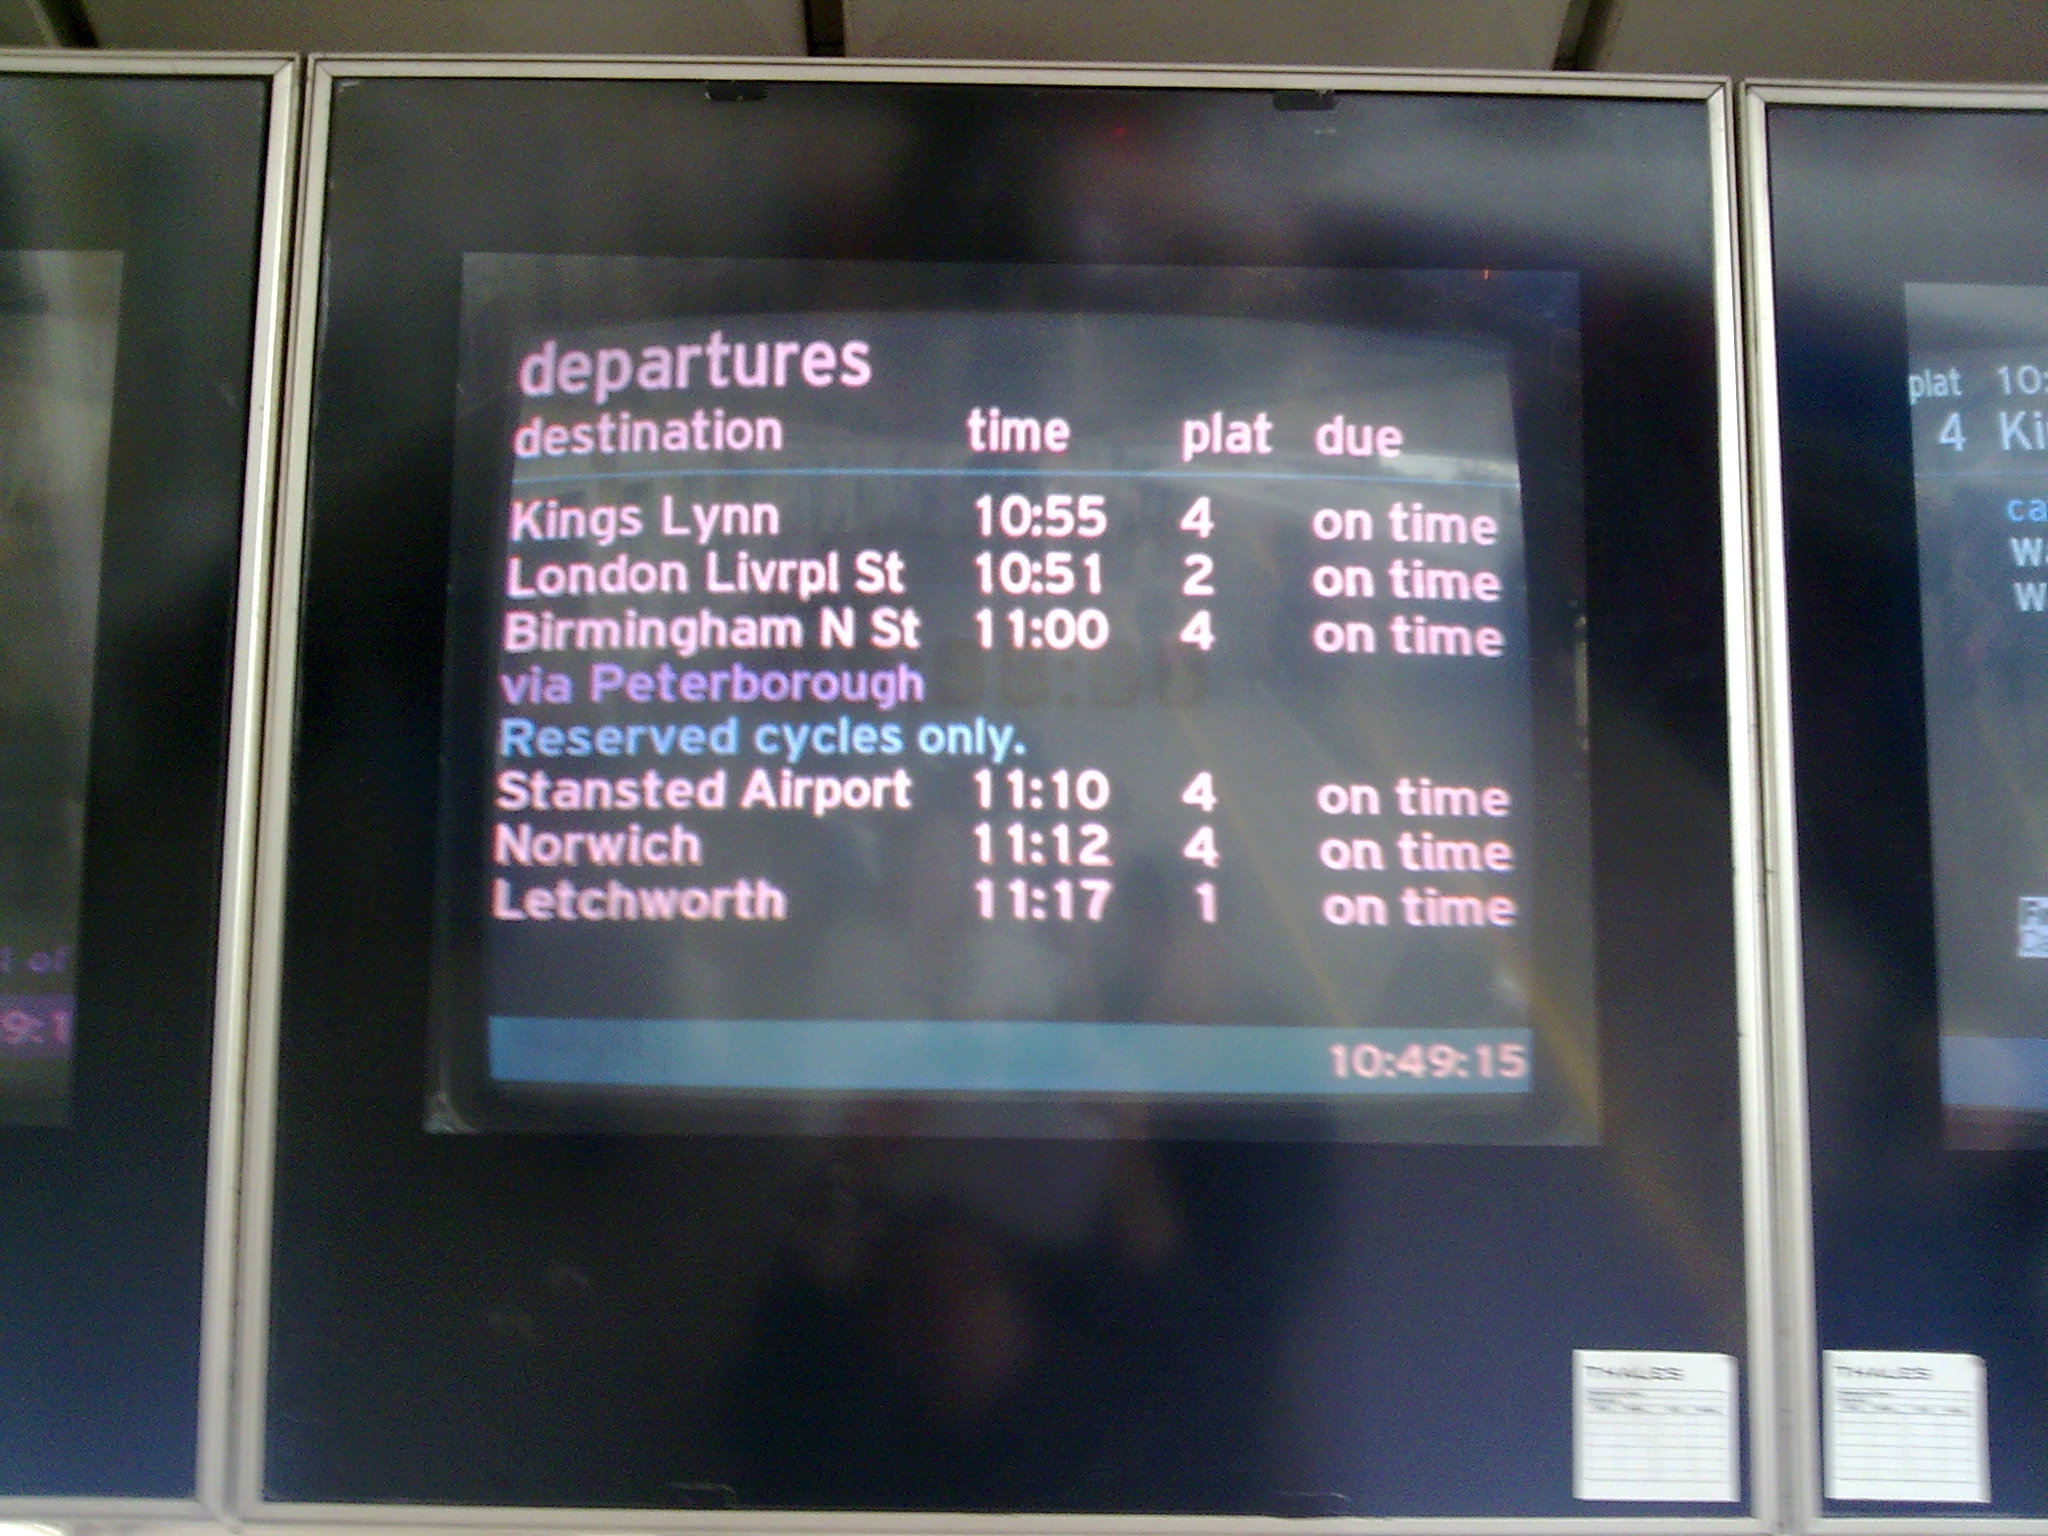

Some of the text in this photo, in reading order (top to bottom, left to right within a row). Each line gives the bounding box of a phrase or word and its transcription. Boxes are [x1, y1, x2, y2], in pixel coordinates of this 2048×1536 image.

[519, 332, 872, 404] departures
[1909, 367, 1962, 404] plat
[514, 407, 1404, 463] destination time plat due
[1938, 412, 1967, 451] 4
[2000, 411, 2048, 450] Ki
[511, 493, 1498, 547] Kings Lynn 10:55 4 on time
[507, 549, 1501, 602] London Livrpl St 10:51 2 on time
[2011, 537, 2048, 566] W
[504, 606, 1503, 658] Birmingham N St 11:00 4 on time
[501, 662, 925, 710] via Peterborough
[501, 714, 1027, 764] Reserved cycles only.
[497, 767, 1509, 818] Stansted Airport 11:10 4 on time
[495, 821, 1512, 873] Norwich 11:12 4 on time
[494, 877, 1515, 927] Letchworth 11:17 1 on time
[1331, 1044, 1524, 1077] 10:49:15
